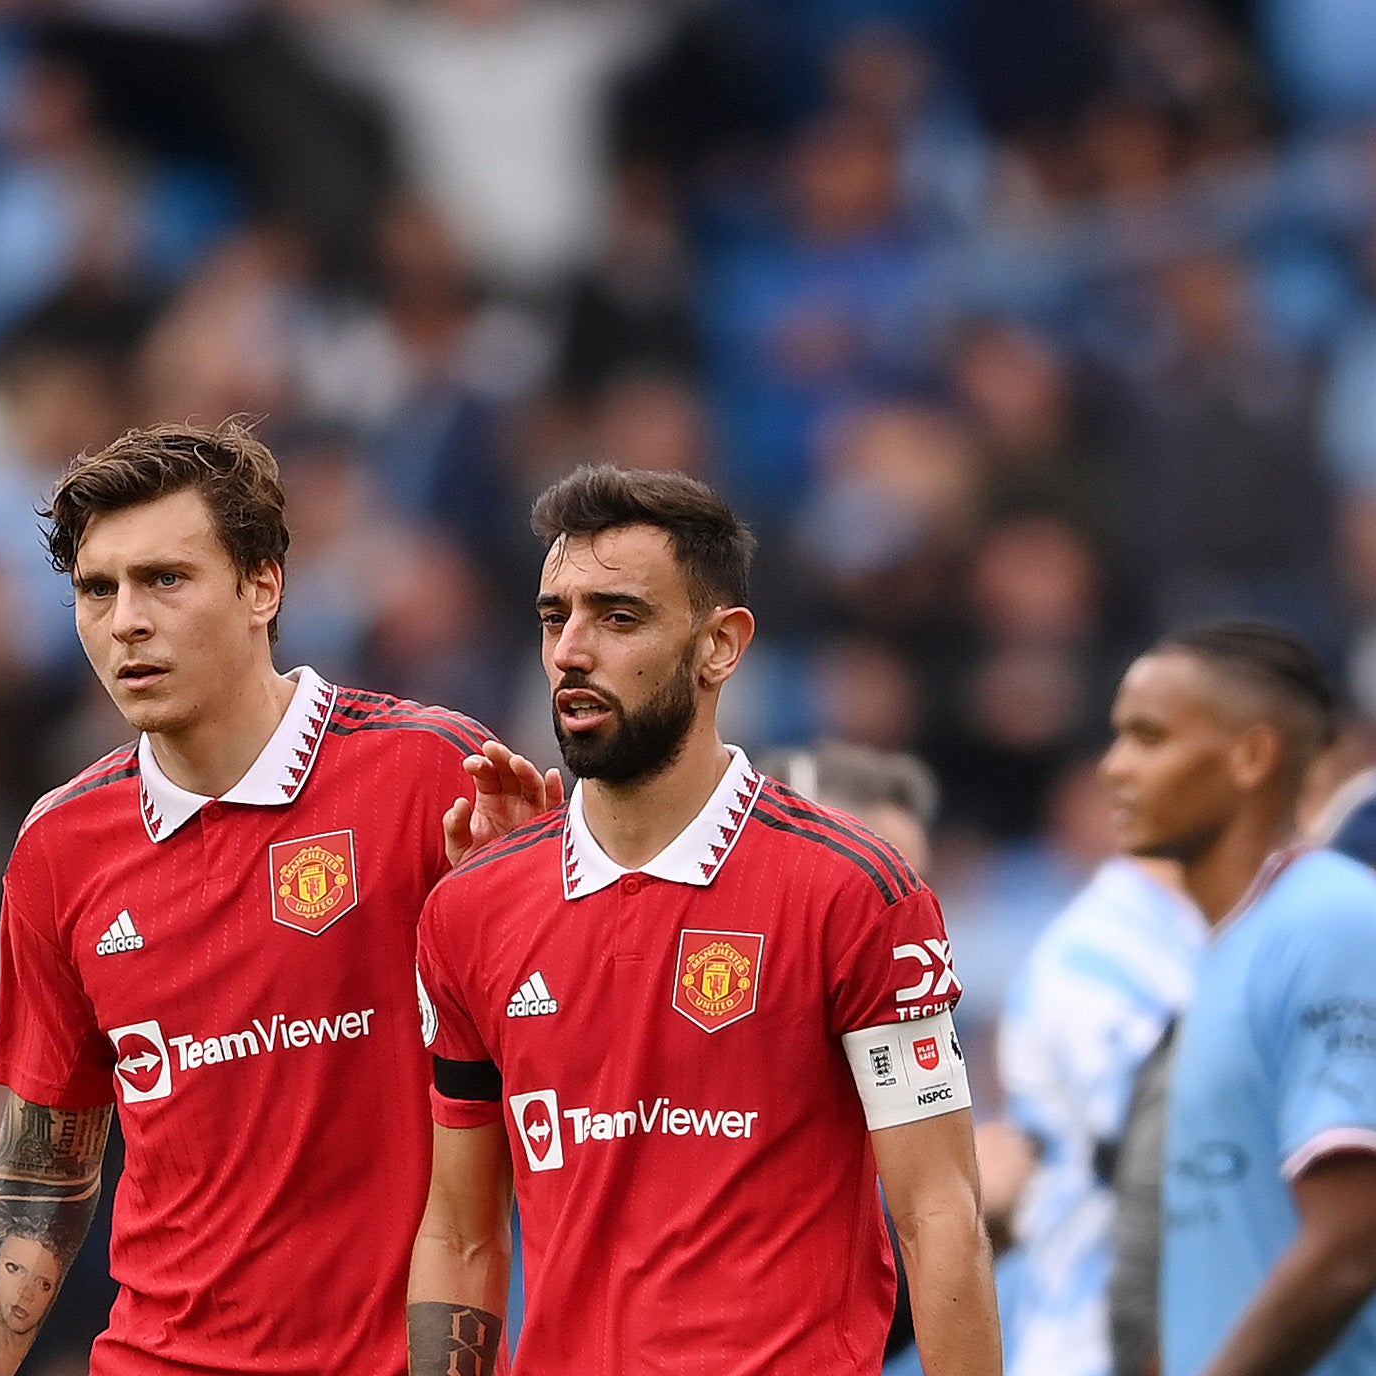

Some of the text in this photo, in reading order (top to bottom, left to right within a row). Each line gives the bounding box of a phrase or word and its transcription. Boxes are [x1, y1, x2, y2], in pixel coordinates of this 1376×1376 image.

[285, 851, 340, 879] MANCHESTER
[295, 897, 334, 914] UNITED
[96, 935, 144, 956] adidas
[690, 947, 745, 974] MANCHESTER
[506, 999, 558, 1018] adidas
[695, 996, 734, 1011] UNITED
[168, 1008, 374, 1072] TeamViewer
[916, 1087, 953, 1106] NSPCC
